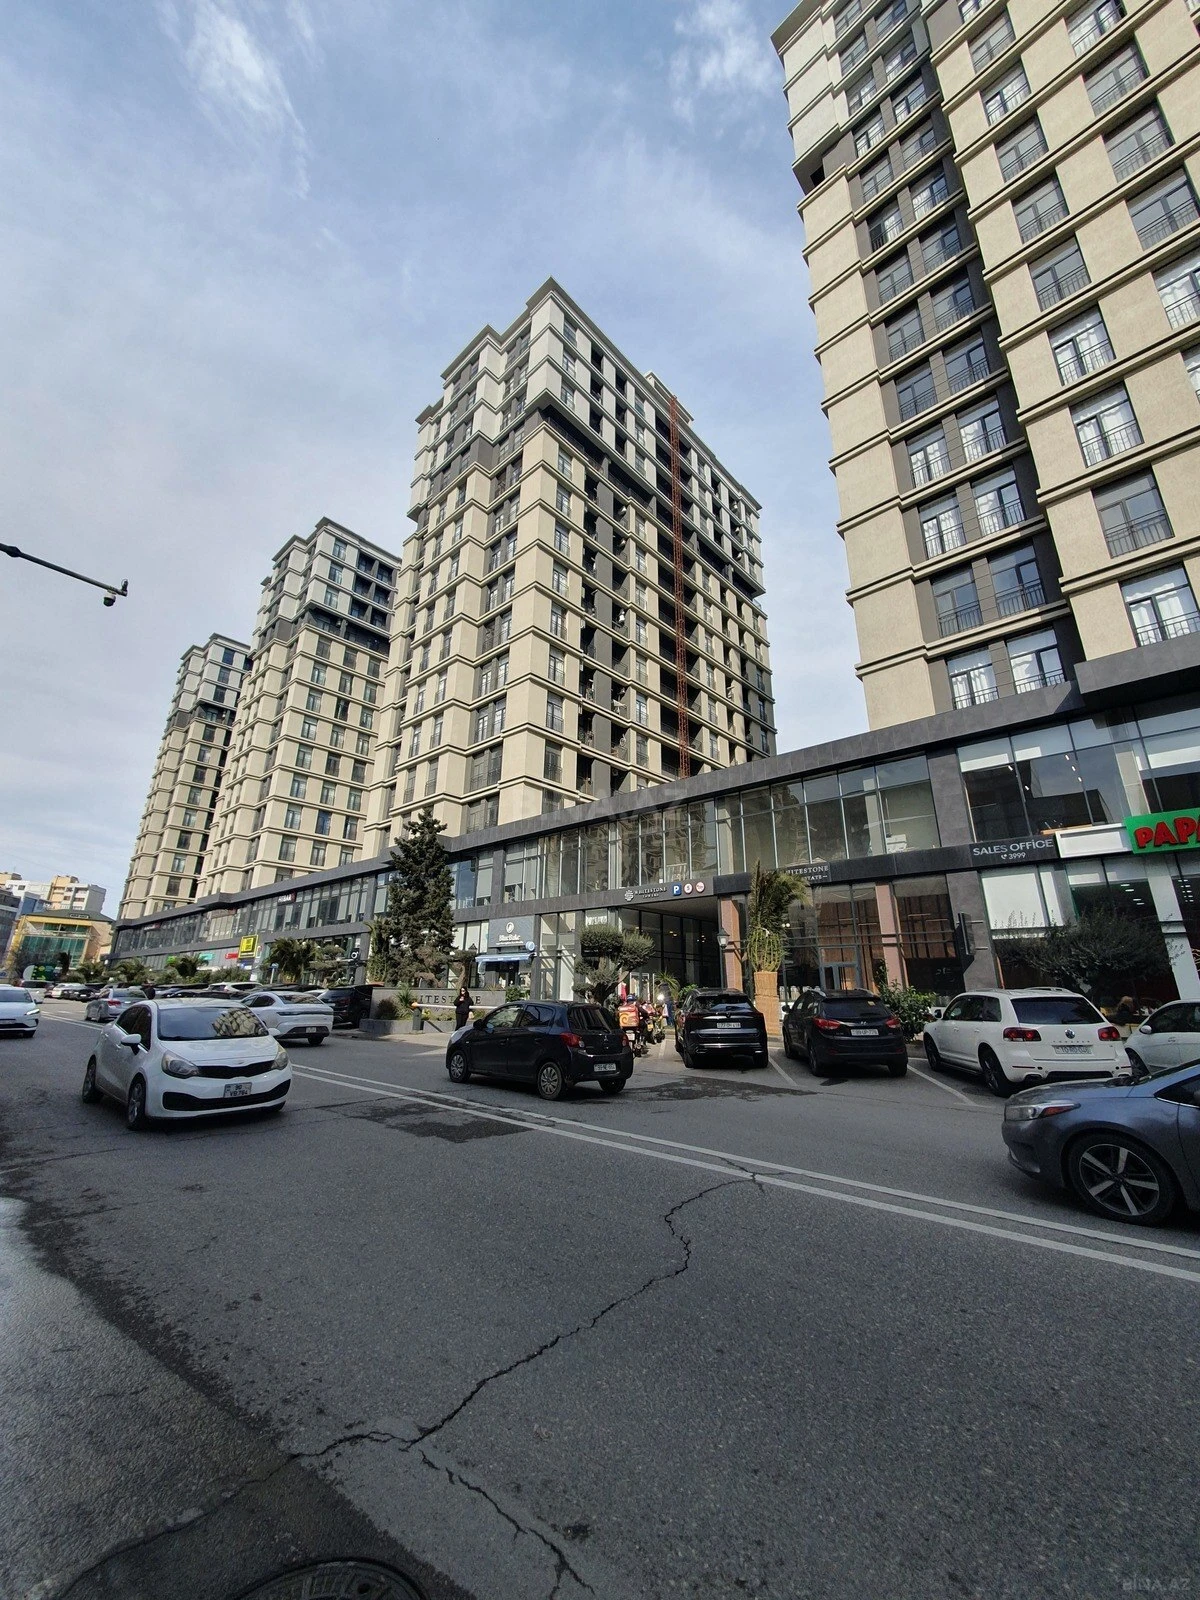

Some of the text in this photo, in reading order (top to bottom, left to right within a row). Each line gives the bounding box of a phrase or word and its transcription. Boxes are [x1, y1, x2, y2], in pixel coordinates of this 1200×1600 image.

[1134, 816, 1200, 848] PAP
[973, 845, 1008, 856] SALES
[1008, 852, 1026, 860] 3999
